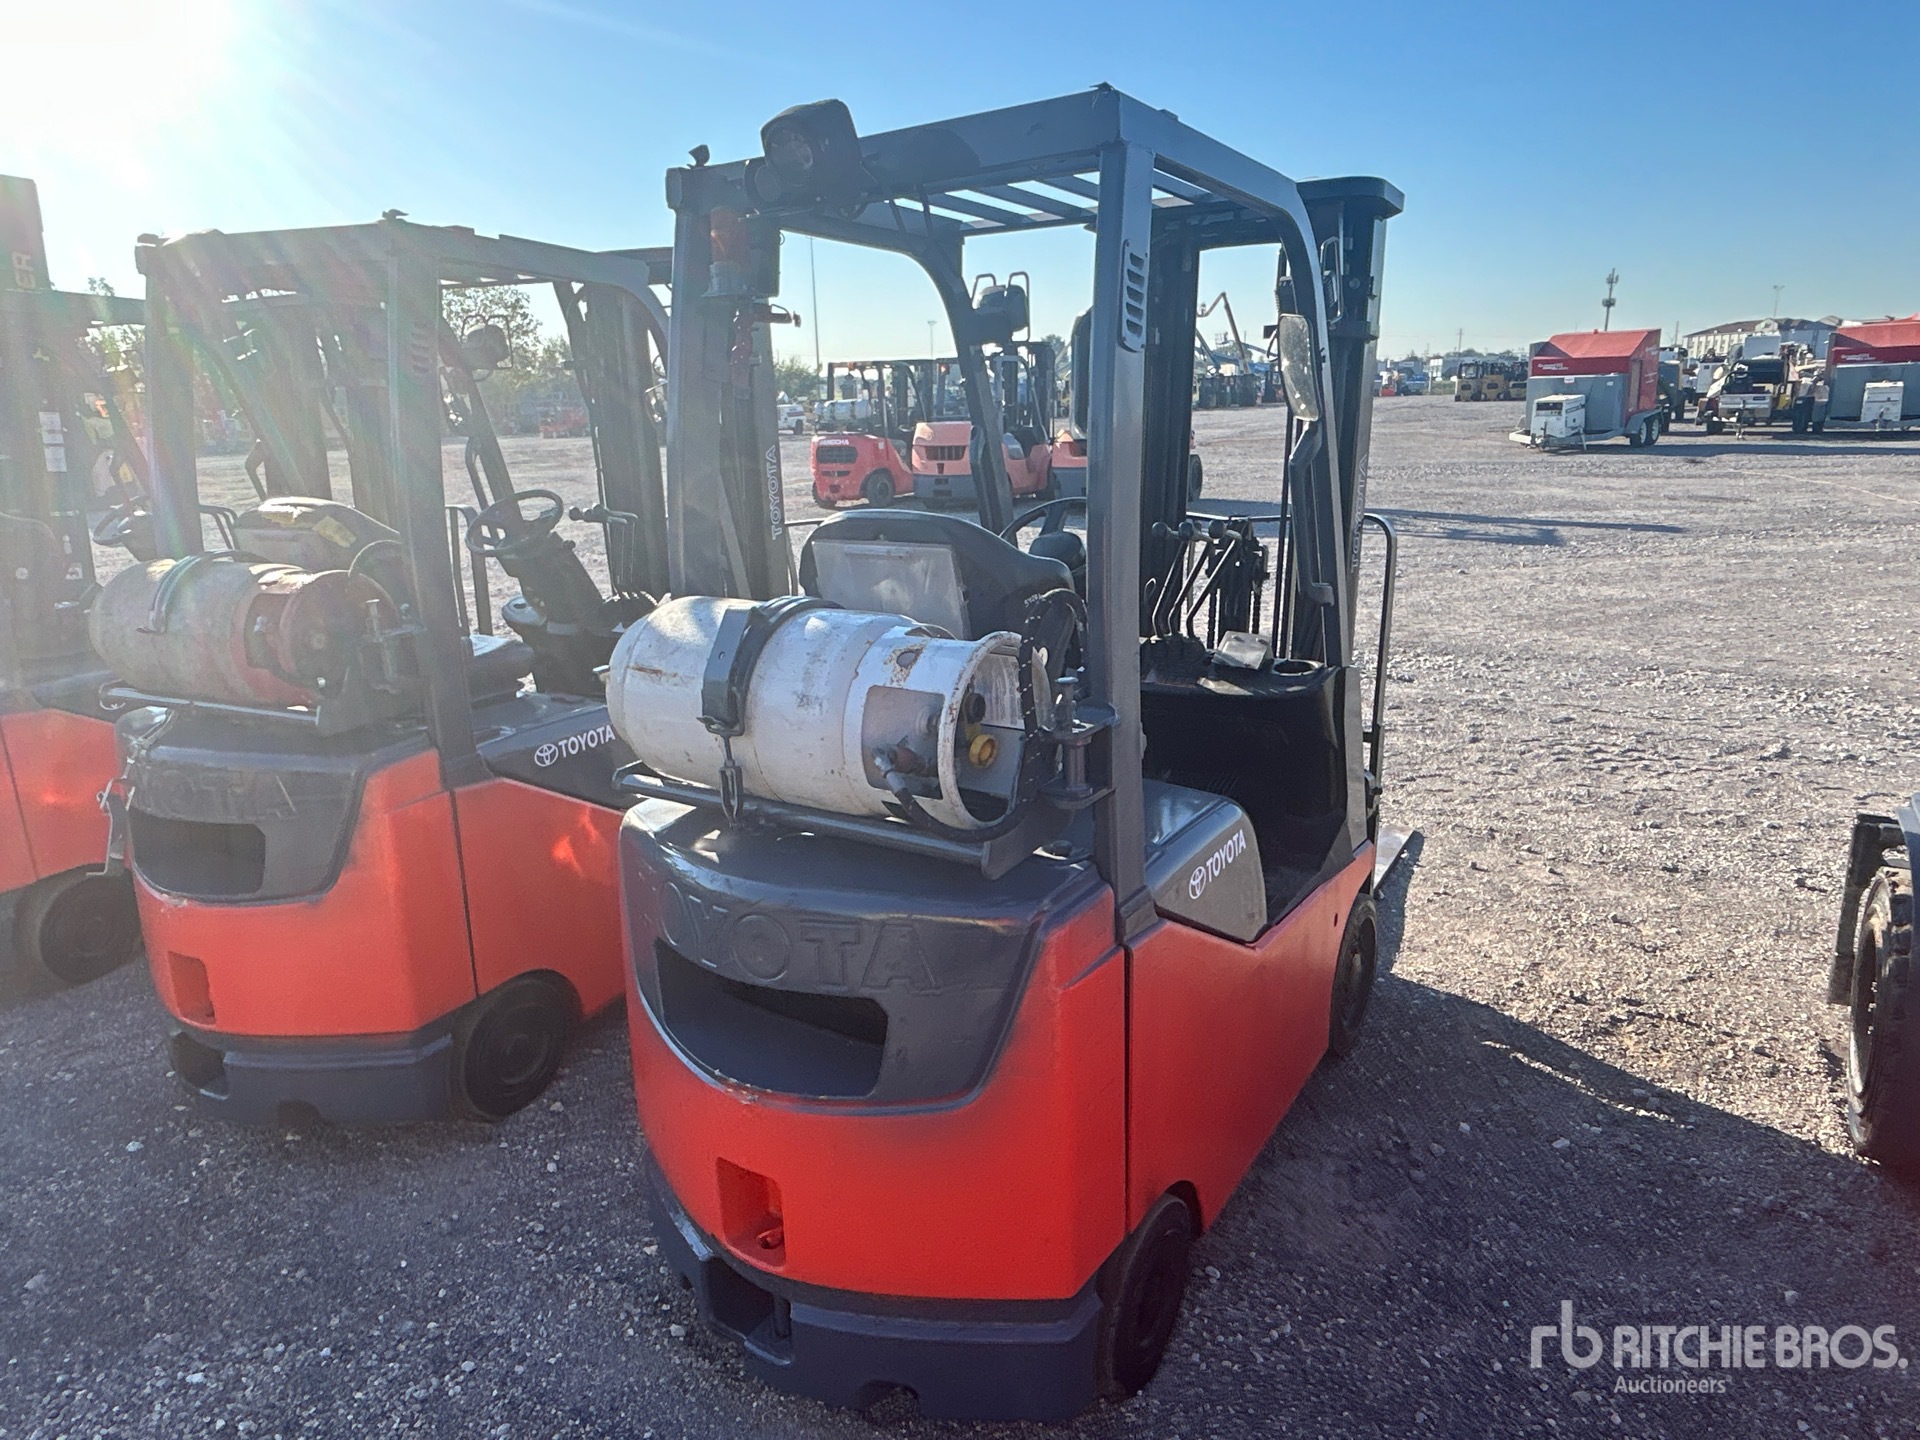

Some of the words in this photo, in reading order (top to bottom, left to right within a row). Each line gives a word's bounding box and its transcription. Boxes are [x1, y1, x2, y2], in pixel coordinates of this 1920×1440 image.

[765, 444, 783, 541] TOYOTA
[558, 724, 616, 758] TOYOTA
[1206, 829, 1247, 883] TOYOTA
